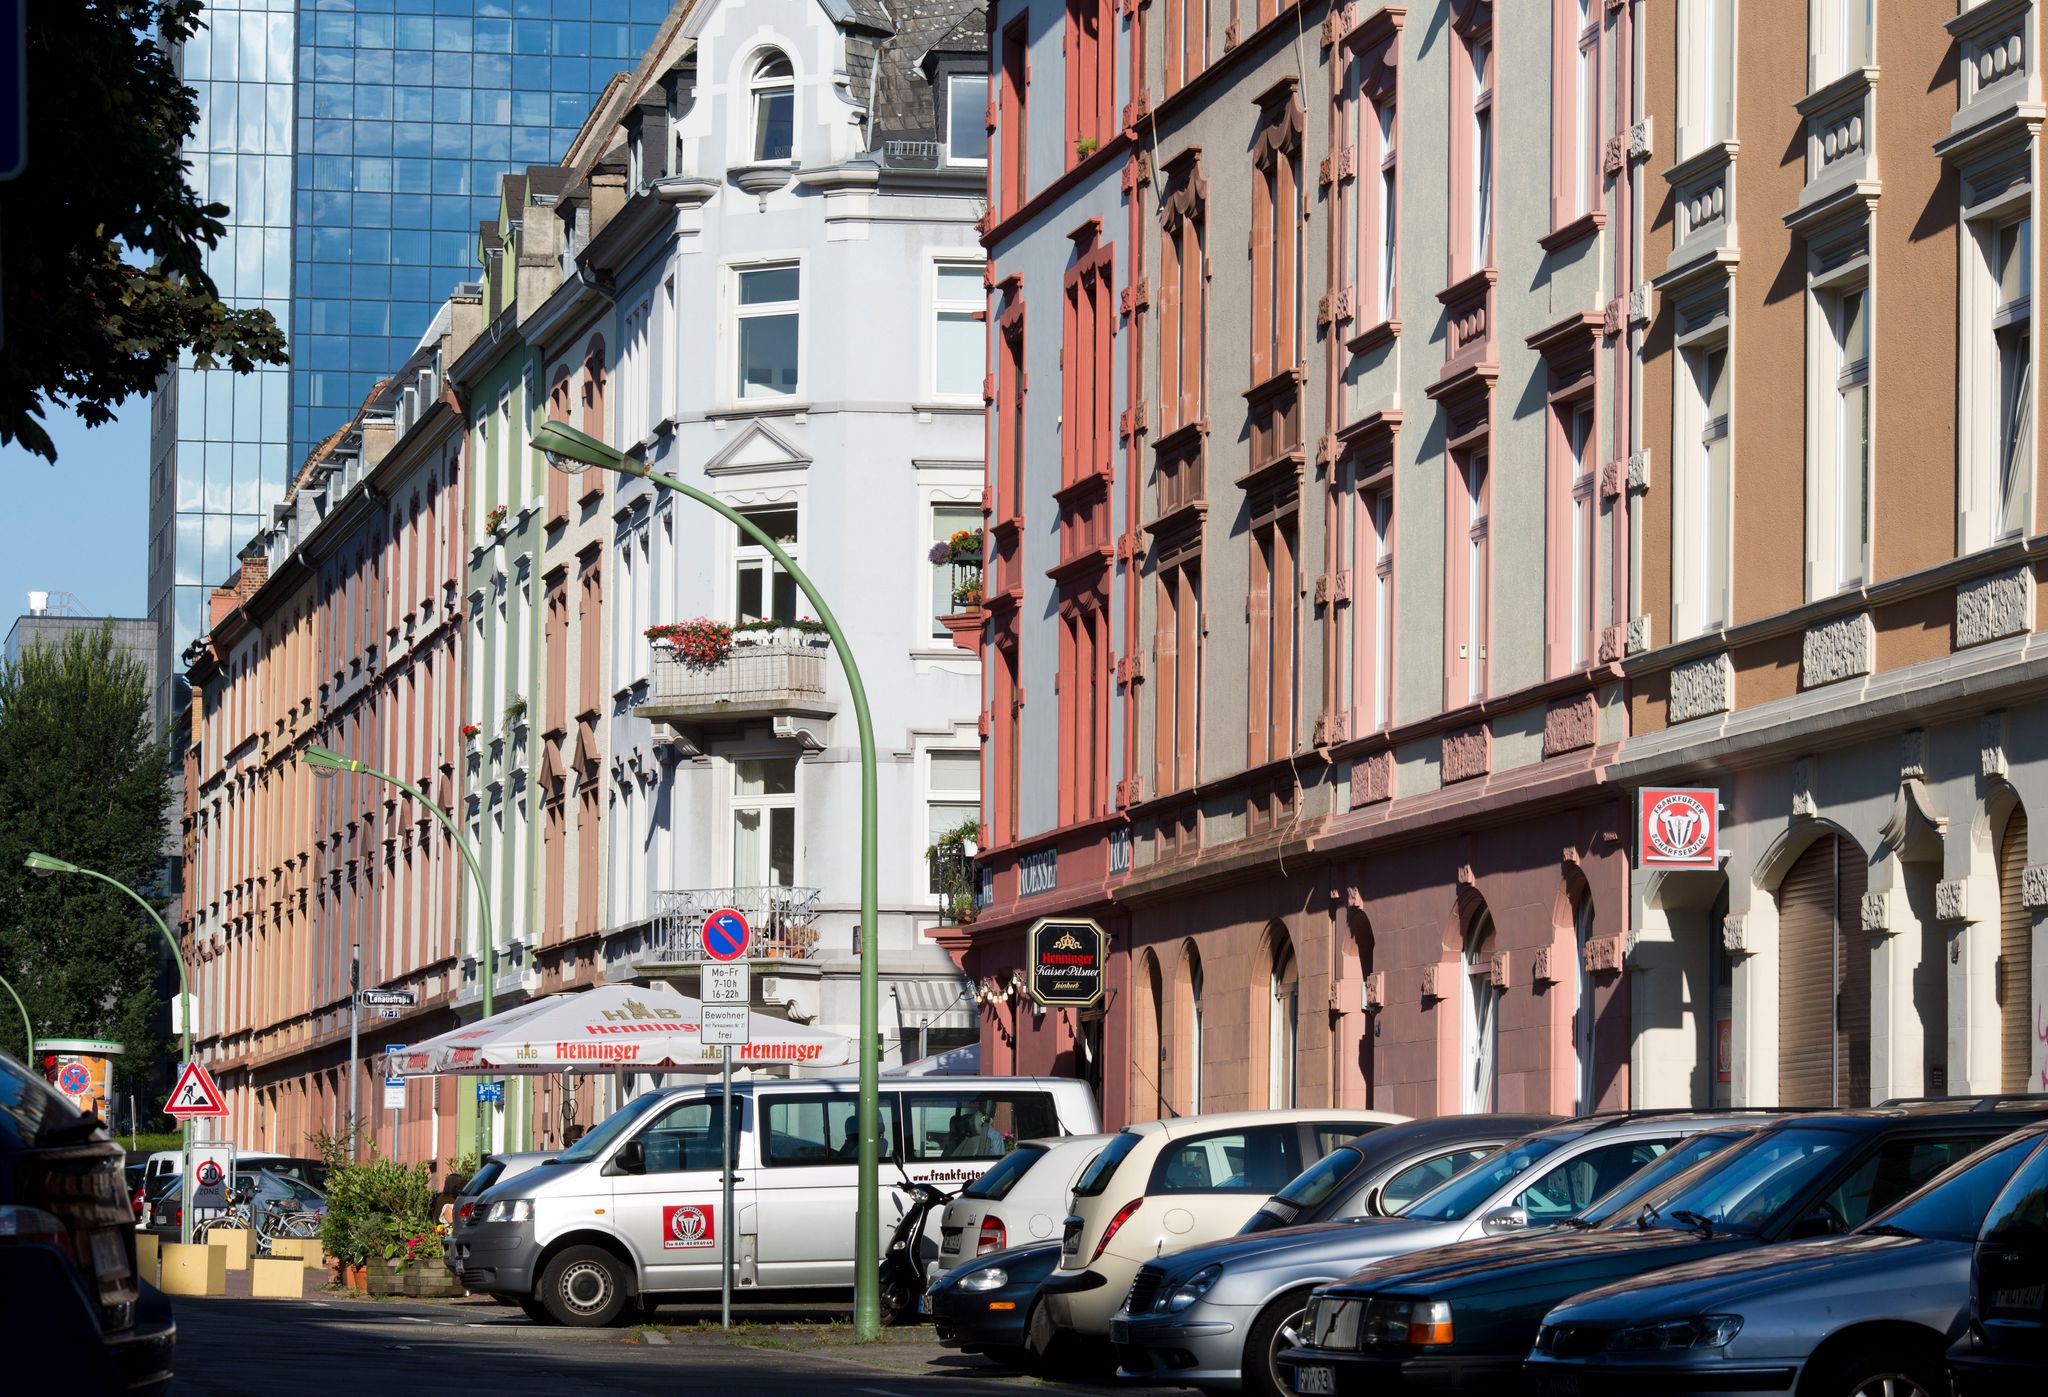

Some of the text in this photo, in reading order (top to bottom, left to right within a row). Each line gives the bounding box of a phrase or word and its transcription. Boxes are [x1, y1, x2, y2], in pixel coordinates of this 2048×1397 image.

[1654, 795, 1704, 814] FRANKFURTER
[1652, 833, 1707, 856] SCHARFSERVICE
[1042, 952, 1094, 966] Henninger
[711, 968, 739, 977] Mo-Fr
[1035, 964, 1100, 977] Kaiser Pilsner
[370, 994, 411, 1005] Lenaustraße
[712, 990, 739, 999] 16-22h
[705, 1011, 745, 1020] Bewohner
[585, 1023, 700, 1035] Henning
[718, 1031, 732, 1039] frei
[556, 1041, 640, 1062] Henninger
[740, 1041, 823, 1062] Henninger
[202, 1168, 217, 1180] 30
[199, 1188, 220, 1196] ZONE
